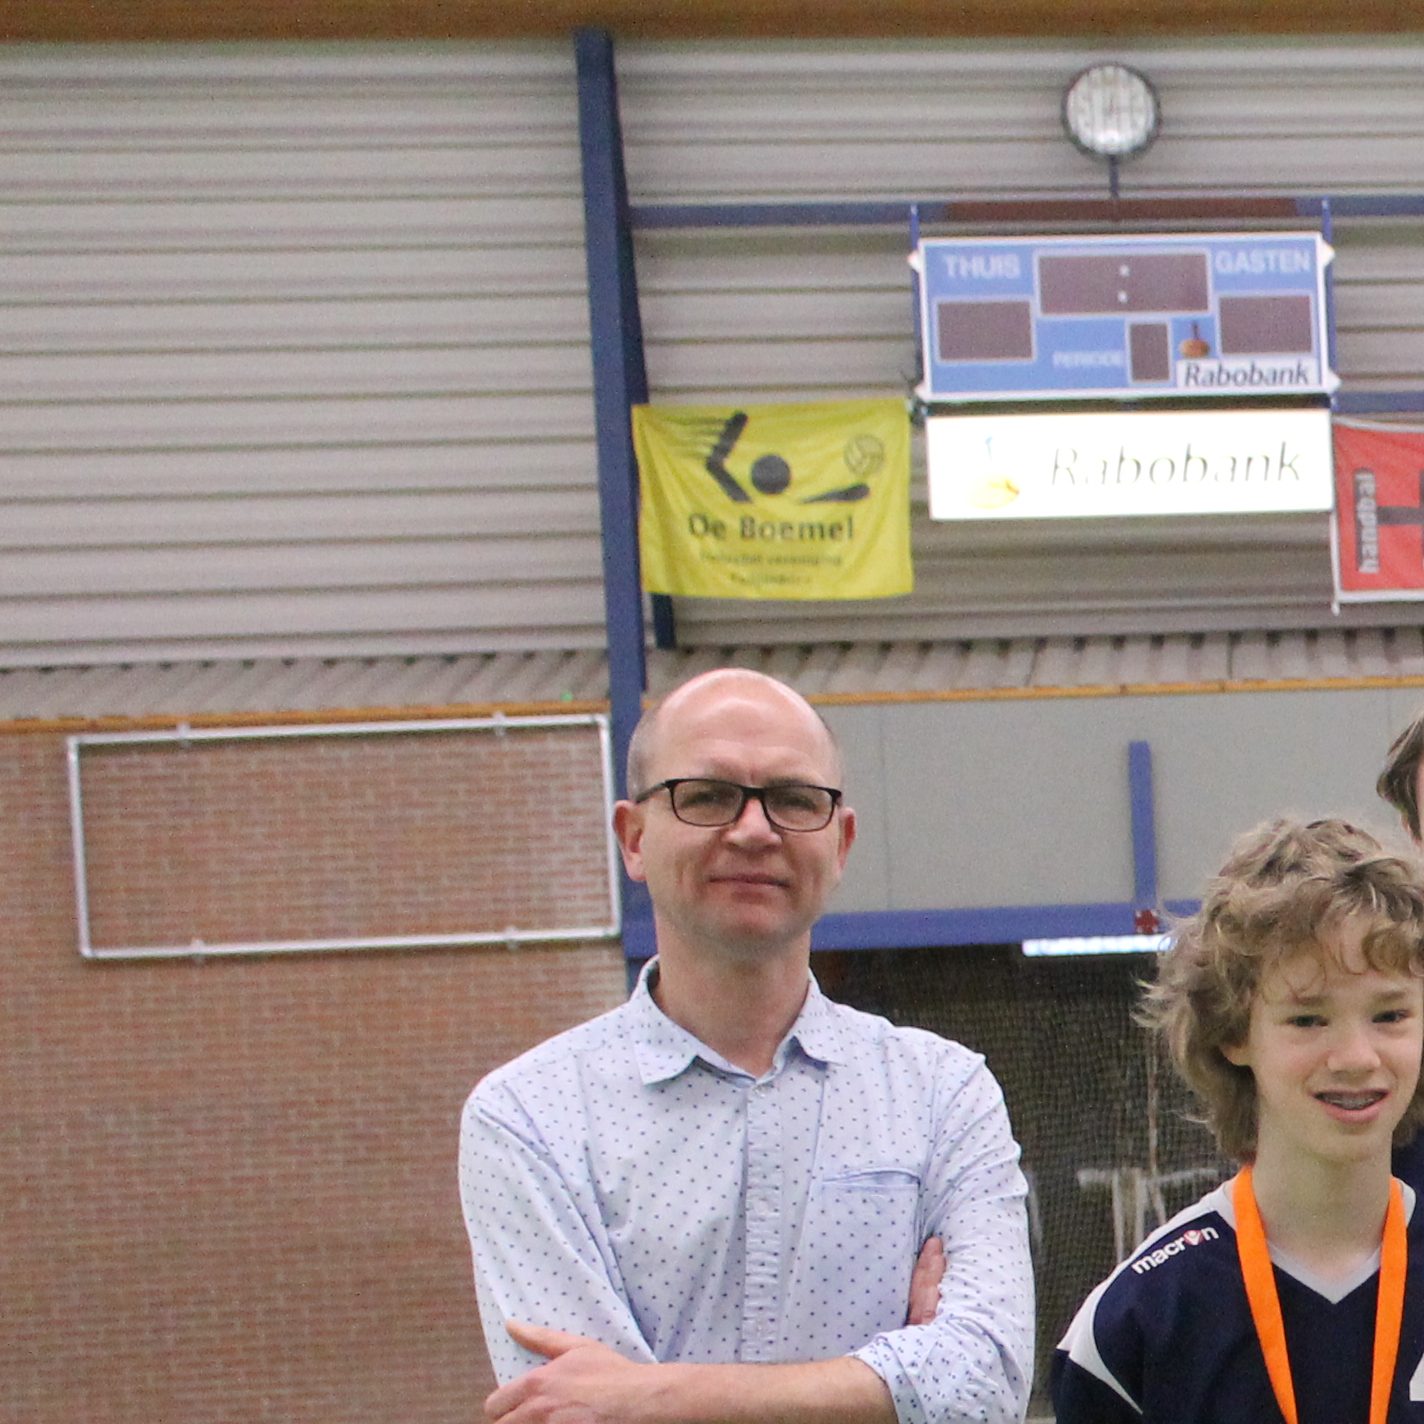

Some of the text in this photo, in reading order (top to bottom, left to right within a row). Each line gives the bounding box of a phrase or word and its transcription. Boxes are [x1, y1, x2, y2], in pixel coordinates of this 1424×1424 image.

[944, 254, 1020, 279] THUIS
[1214, 250, 1311, 274] GASTEN
[1184, 361, 1311, 387] Rabobank
[1051, 441, 1300, 486] Rabobank
[689, 514, 854, 541] De Boemel
[1354, 471, 1380, 573] handbal
[1131, 1224, 1220, 1274] macron
